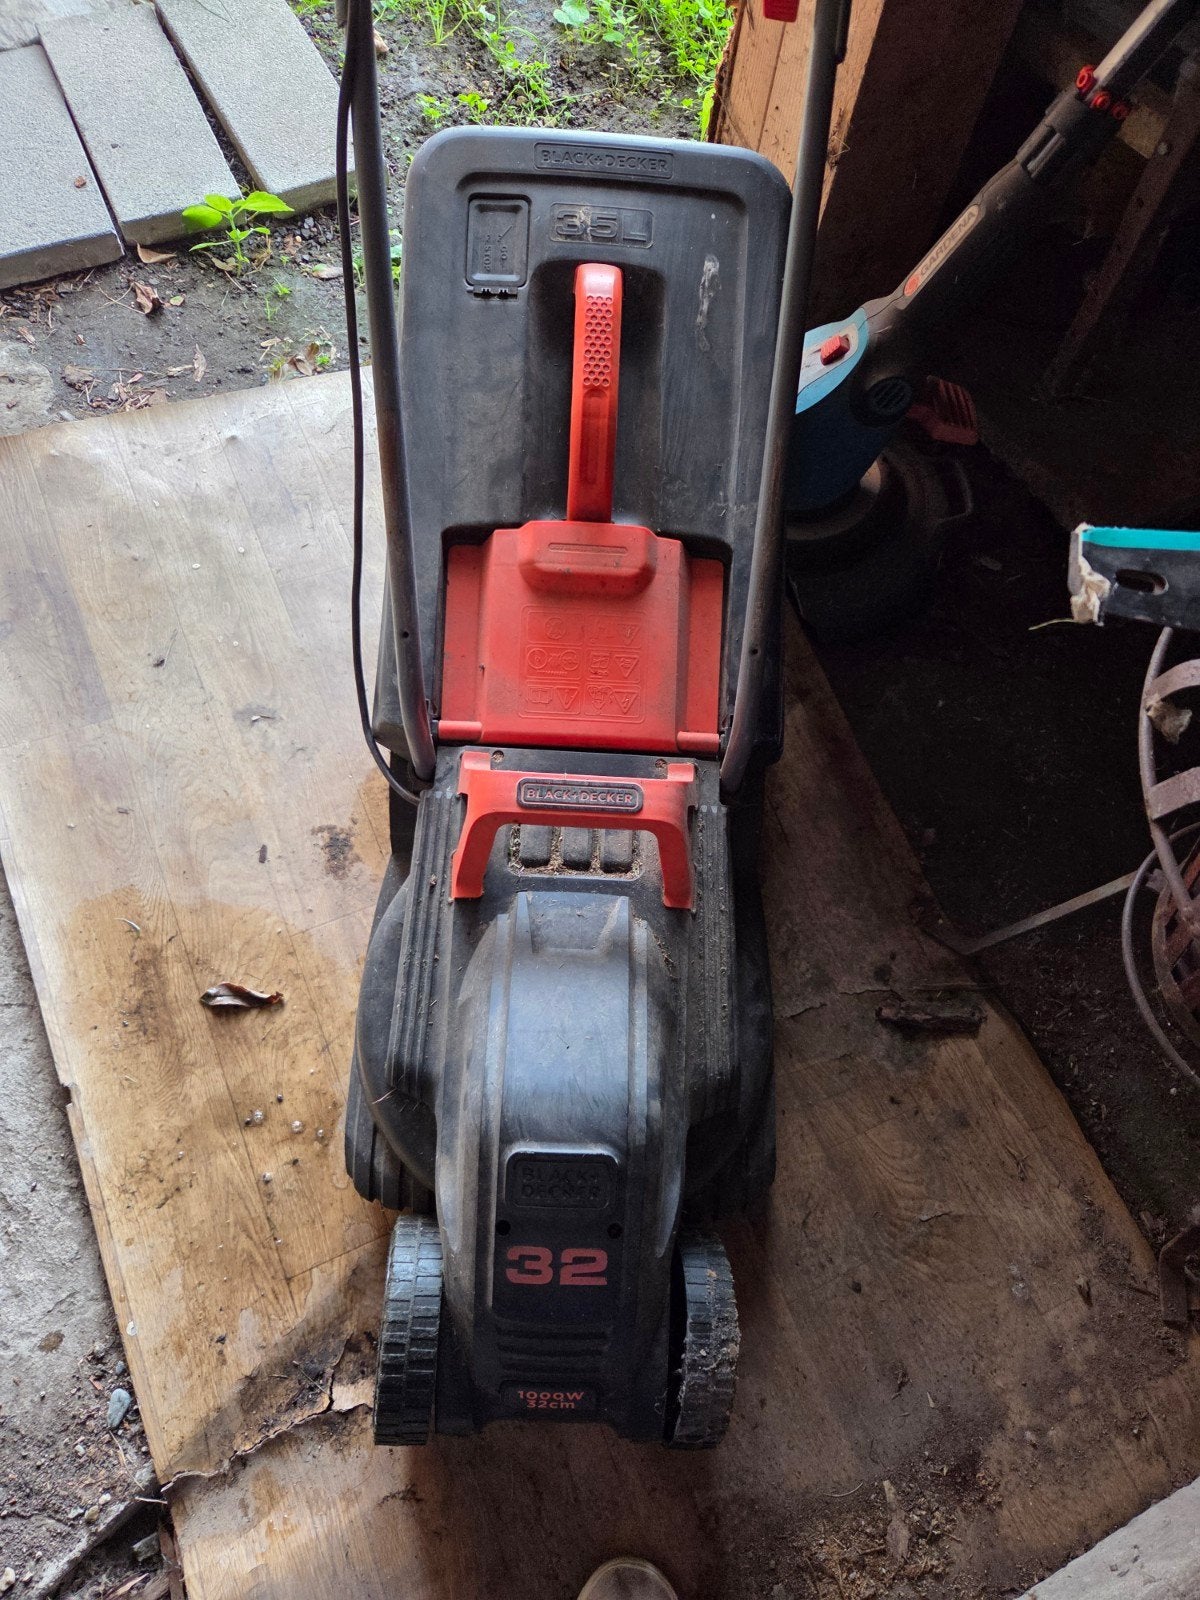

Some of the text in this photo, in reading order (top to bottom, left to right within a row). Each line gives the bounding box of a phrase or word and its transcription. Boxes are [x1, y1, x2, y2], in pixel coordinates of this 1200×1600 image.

[541, 149, 669, 171] BLACK+DECKER
[555, 210, 647, 242] 35L
[920, 212, 976, 275] GARDENA
[526, 789, 633, 803] BLACK+DECKER
[506, 1246, 608, 1285] 32
[518, 1391, 585, 1401] 1000W
[526, 1400, 575, 1409] 32cm
